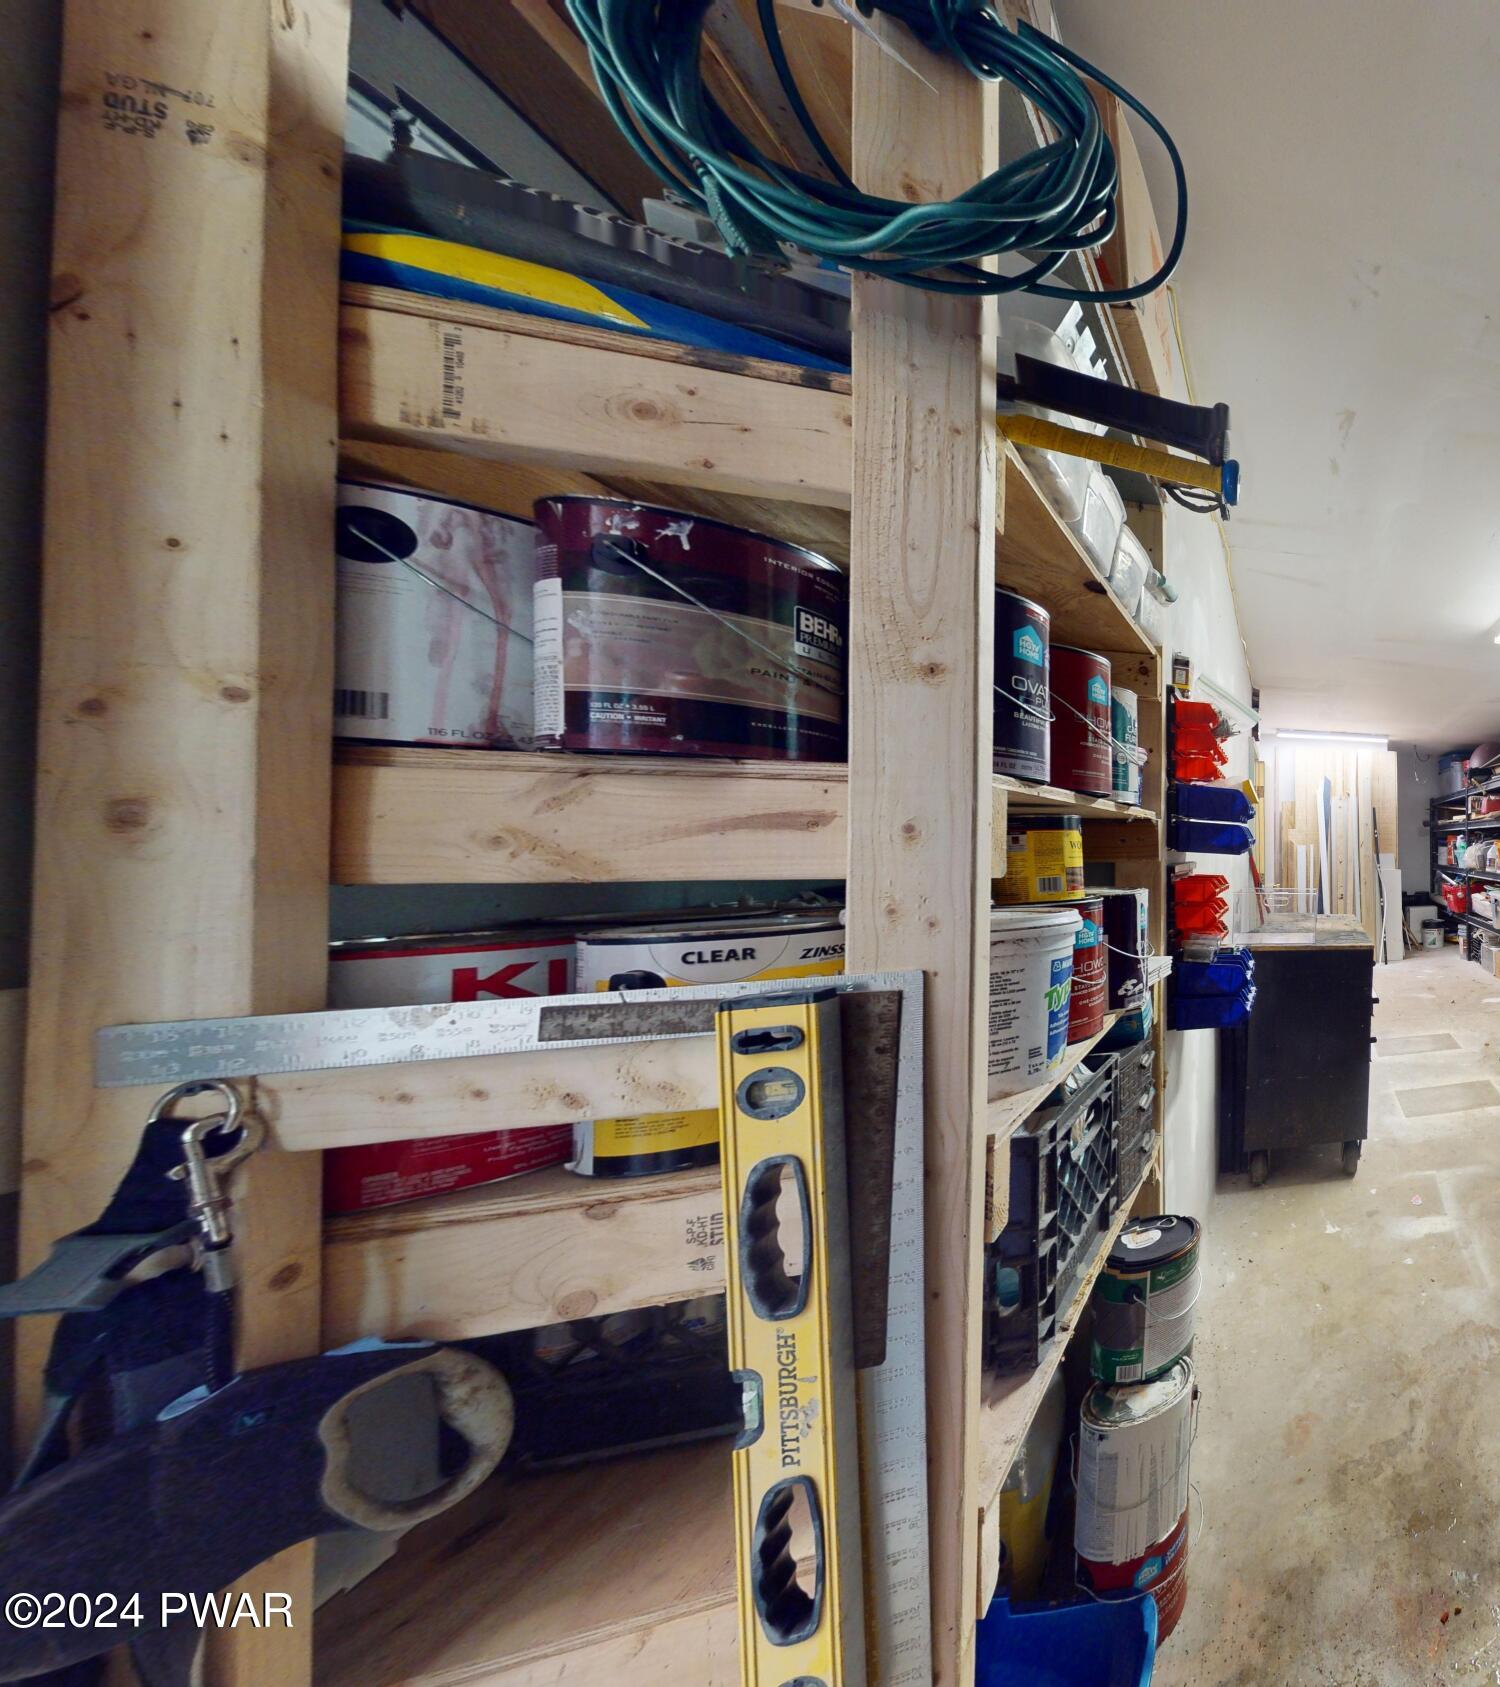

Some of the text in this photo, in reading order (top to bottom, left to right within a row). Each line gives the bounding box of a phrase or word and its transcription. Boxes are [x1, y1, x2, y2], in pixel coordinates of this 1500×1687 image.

[102, 92, 168, 120] STUD
[800, 611, 838, 644] BEHR
[680, 947, 757, 966] CLEAR
[685, 1218, 696, 1245] S-P-F
[697, 1216, 708, 1247] KD-HT
